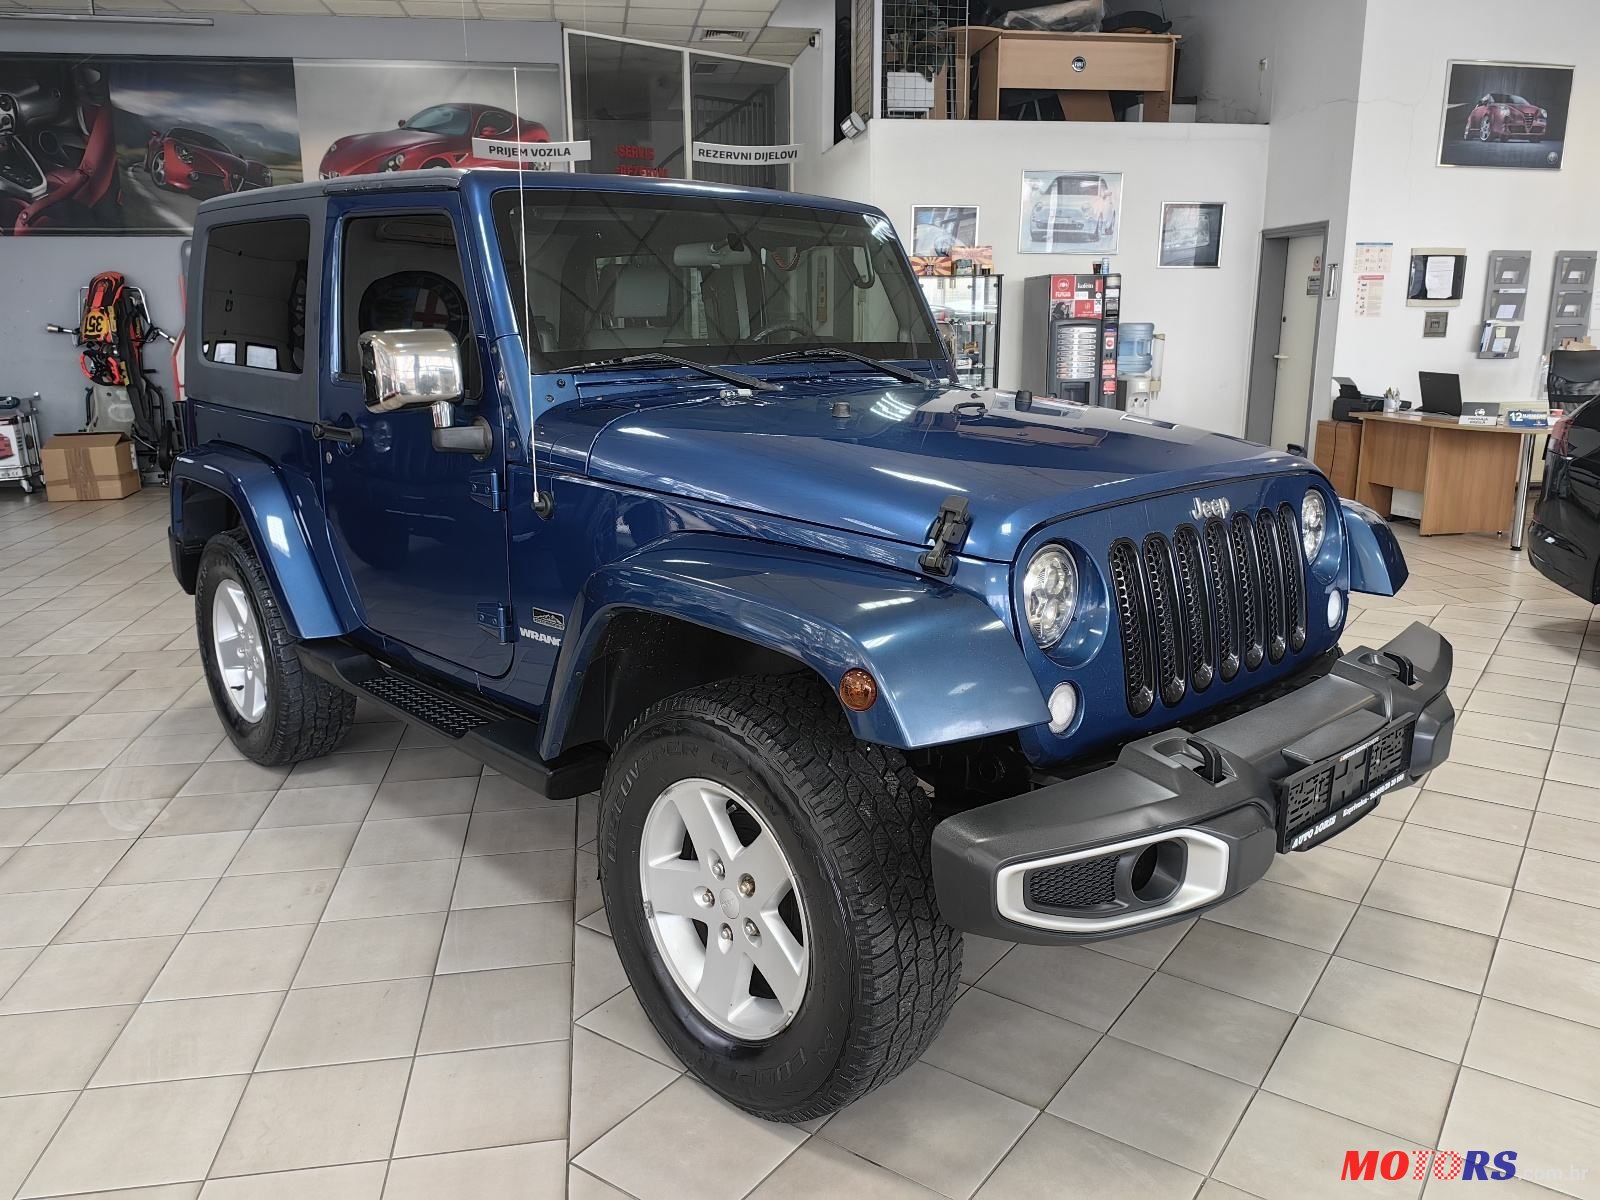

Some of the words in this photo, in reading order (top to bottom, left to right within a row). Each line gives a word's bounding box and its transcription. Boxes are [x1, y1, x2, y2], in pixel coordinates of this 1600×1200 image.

[489, 145, 528, 158] PRIJEM
[530, 147, 572, 157] VOZILA
[698, 148, 752, 161] REZERVNI
[754, 149, 798, 162] DIJELOVI
[84, 315, 104, 333] 351
[1509, 412, 1524, 422] 12
[1190, 496, 1231, 520] Jeep
